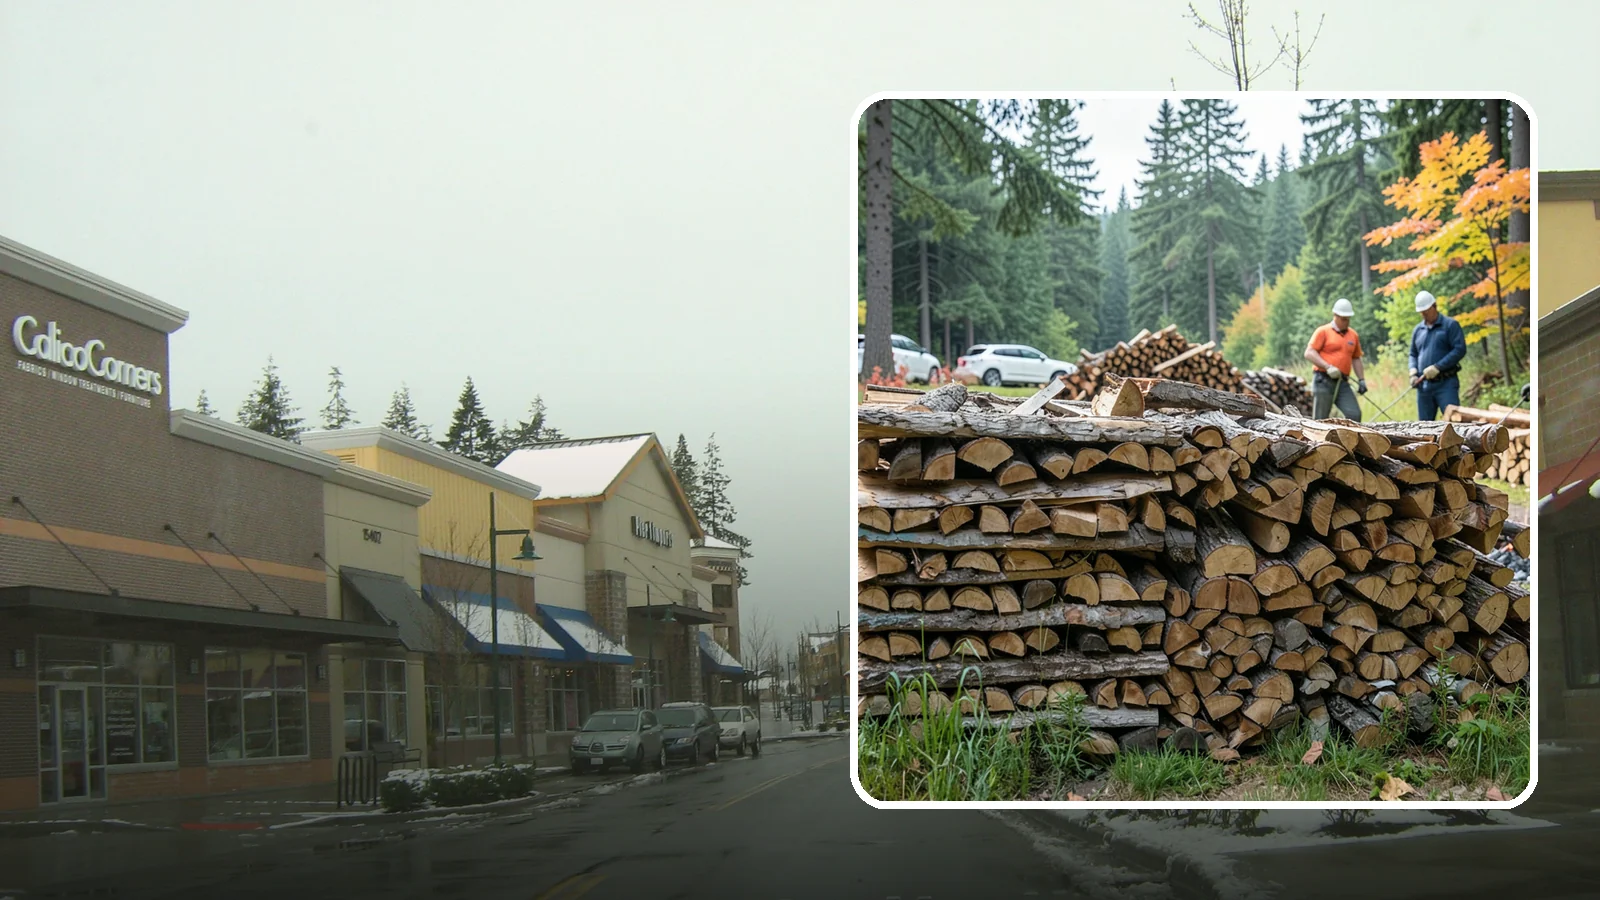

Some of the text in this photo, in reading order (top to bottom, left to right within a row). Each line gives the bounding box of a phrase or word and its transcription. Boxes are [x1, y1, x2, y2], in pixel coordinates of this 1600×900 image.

[17, 360, 47, 377] FABRICS
[51, 370, 78, 387] WINDOW
[78, 378, 116, 398] TREATMENTS
